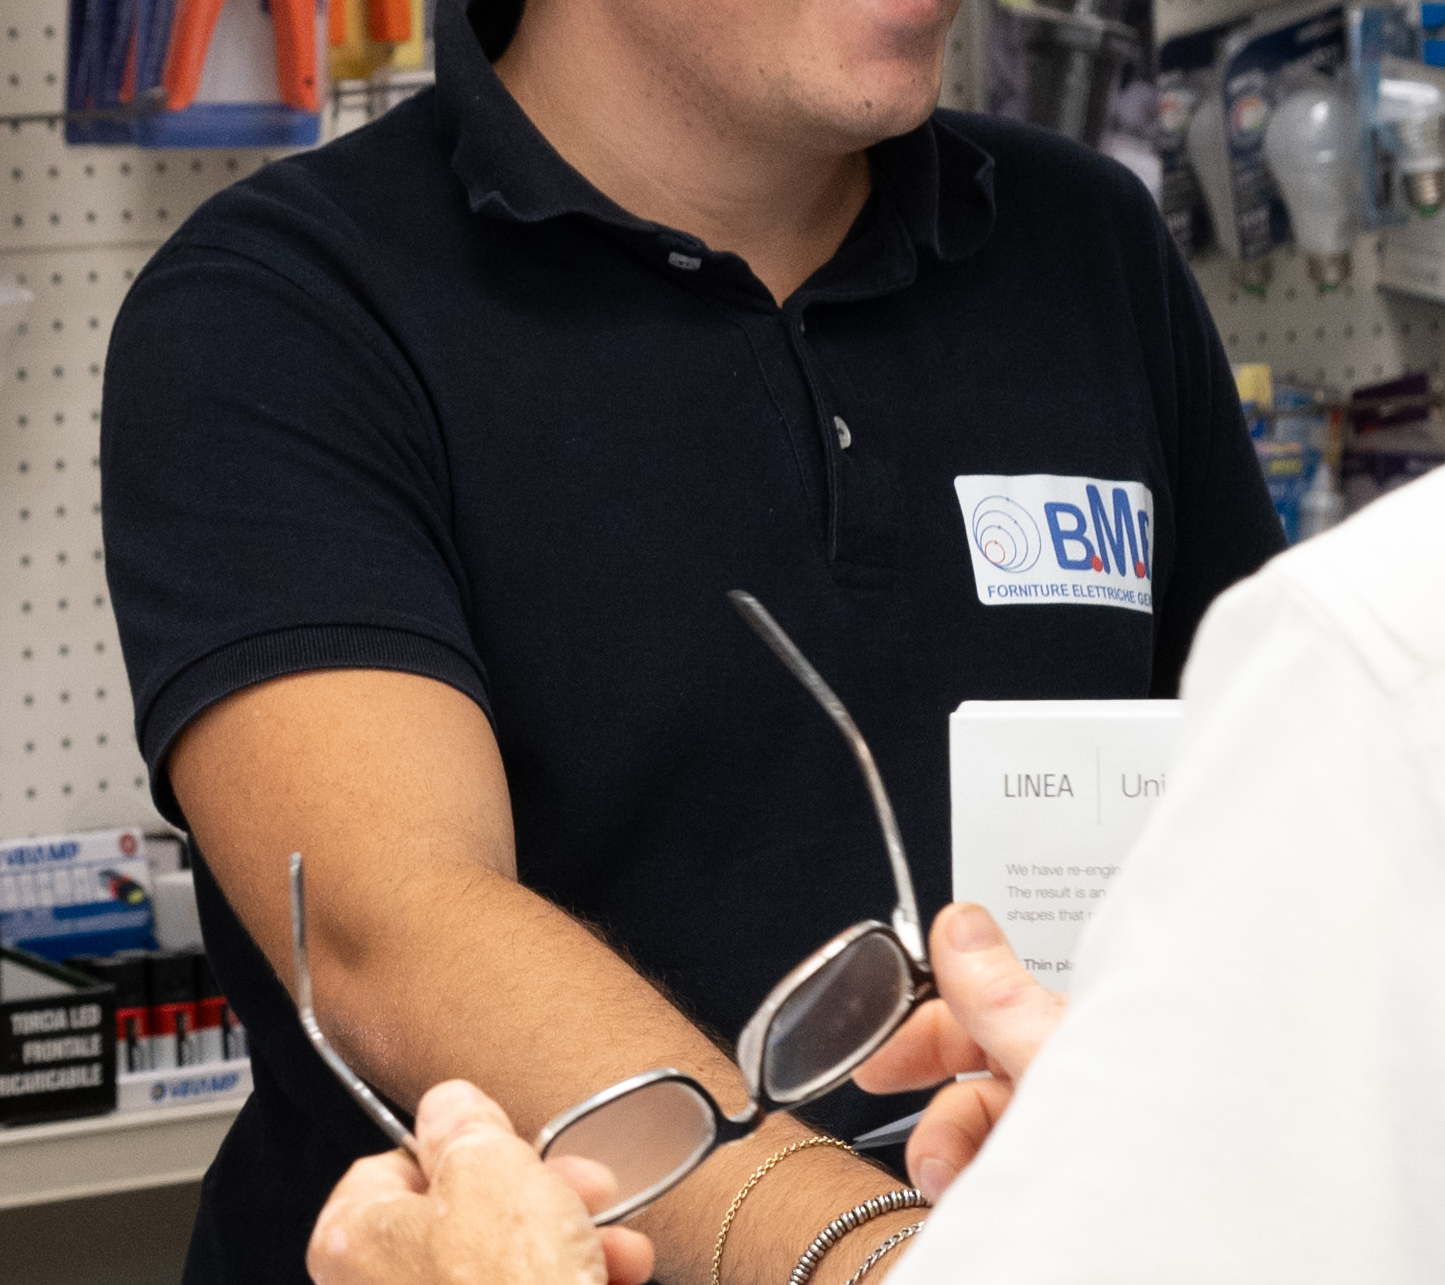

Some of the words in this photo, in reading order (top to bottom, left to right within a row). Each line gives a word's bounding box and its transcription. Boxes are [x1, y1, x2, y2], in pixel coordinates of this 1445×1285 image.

[988, 583, 1070, 599] FORNITURE
[1072, 584, 1136, 604] ELETTRICHE
[1003, 774, 1075, 798] LINEA
[1006, 864, 1028, 876] We
[1032, 863, 1063, 876] have
[1007, 886, 1031, 899] The
[1036, 886, 1071, 899] result
[1075, 886, 1086, 899] is
[1006, 910, 1055, 924] shapes
[1059, 909, 1084, 922] that
[1023, 958, 1052, 971] Thin
[12, 1009, 67, 1035] TORCIA
[70, 1004, 102, 1028] LED
[22, 1033, 102, 1065] FRONTALE
